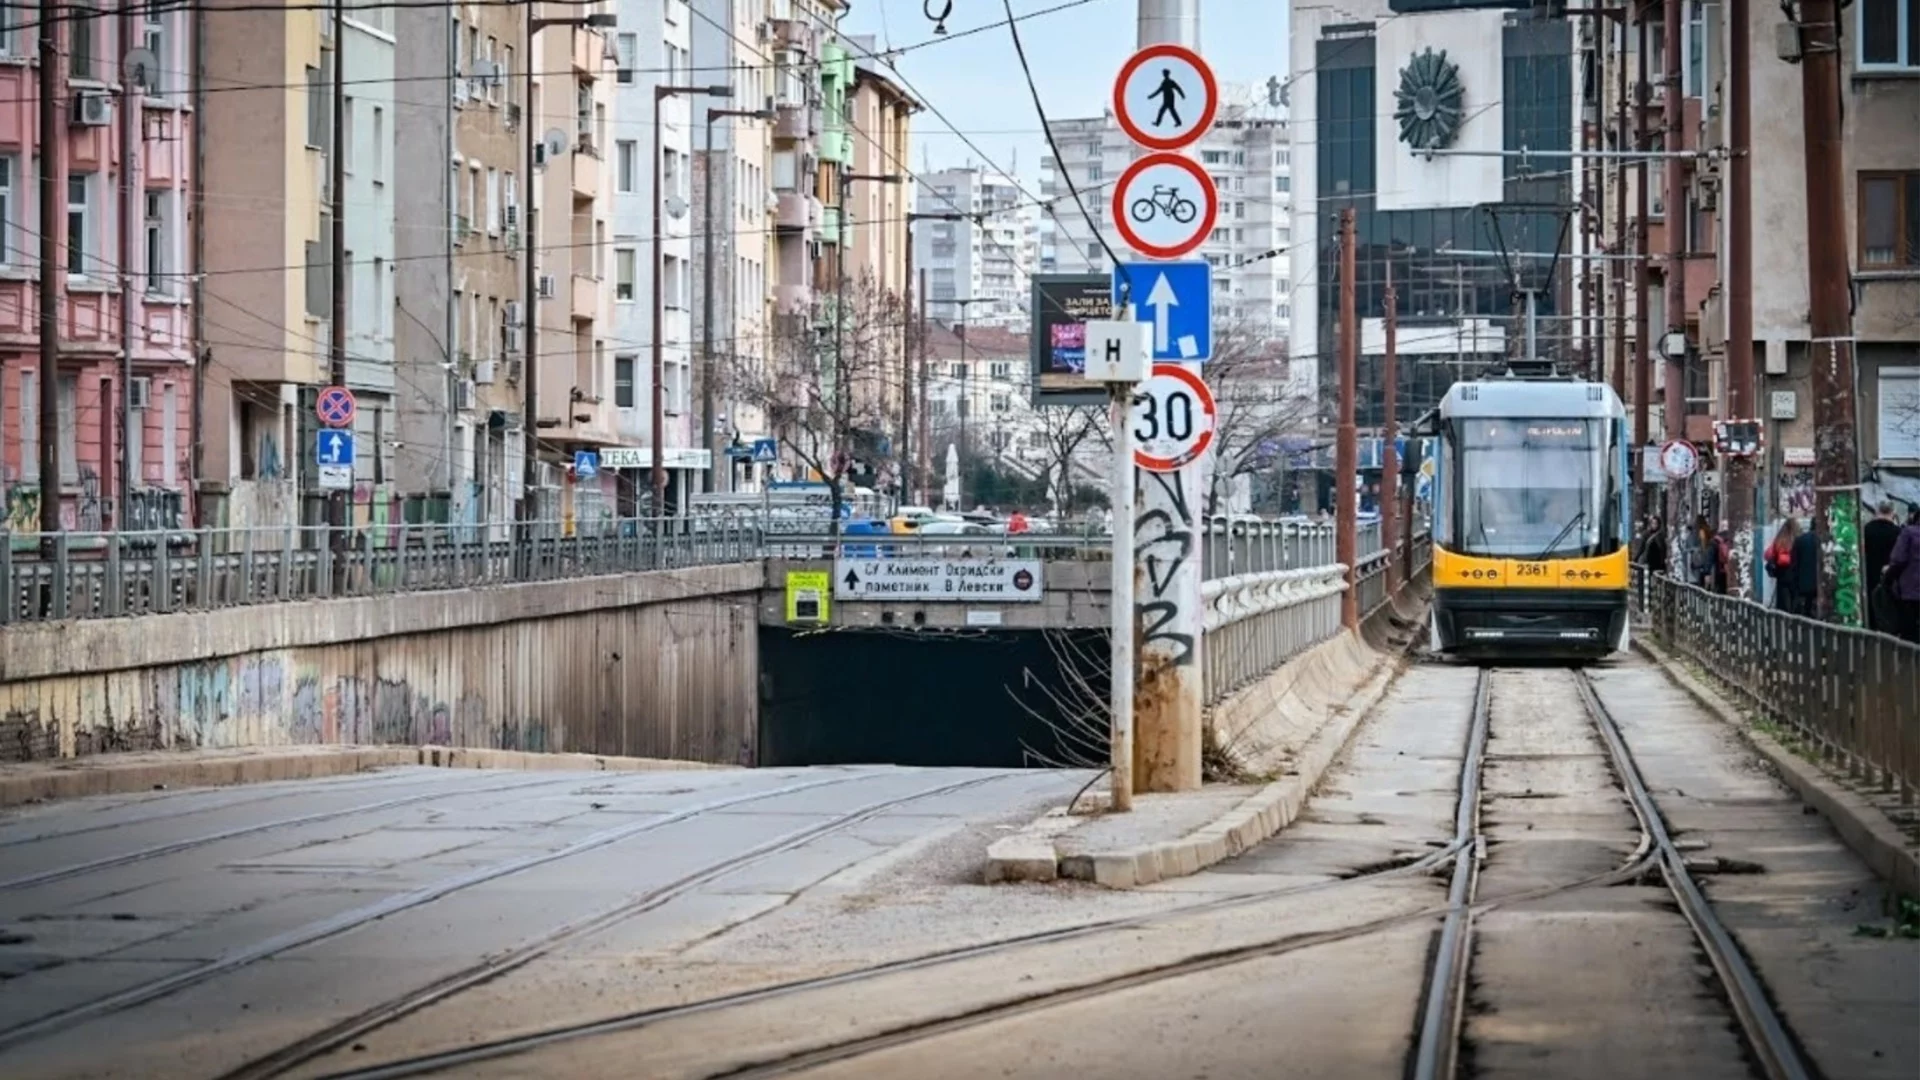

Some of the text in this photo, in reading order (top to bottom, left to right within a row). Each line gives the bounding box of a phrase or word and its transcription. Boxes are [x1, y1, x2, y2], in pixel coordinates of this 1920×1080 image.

[1133, 391, 1192, 442] 30
[887, 562, 940, 576] Климент
[946, 562, 1004, 578] Охридски
[1516, 563, 1548, 576] 2361
[865, 581, 930, 592] паметник
[958, 579, 1003, 592] Левски
